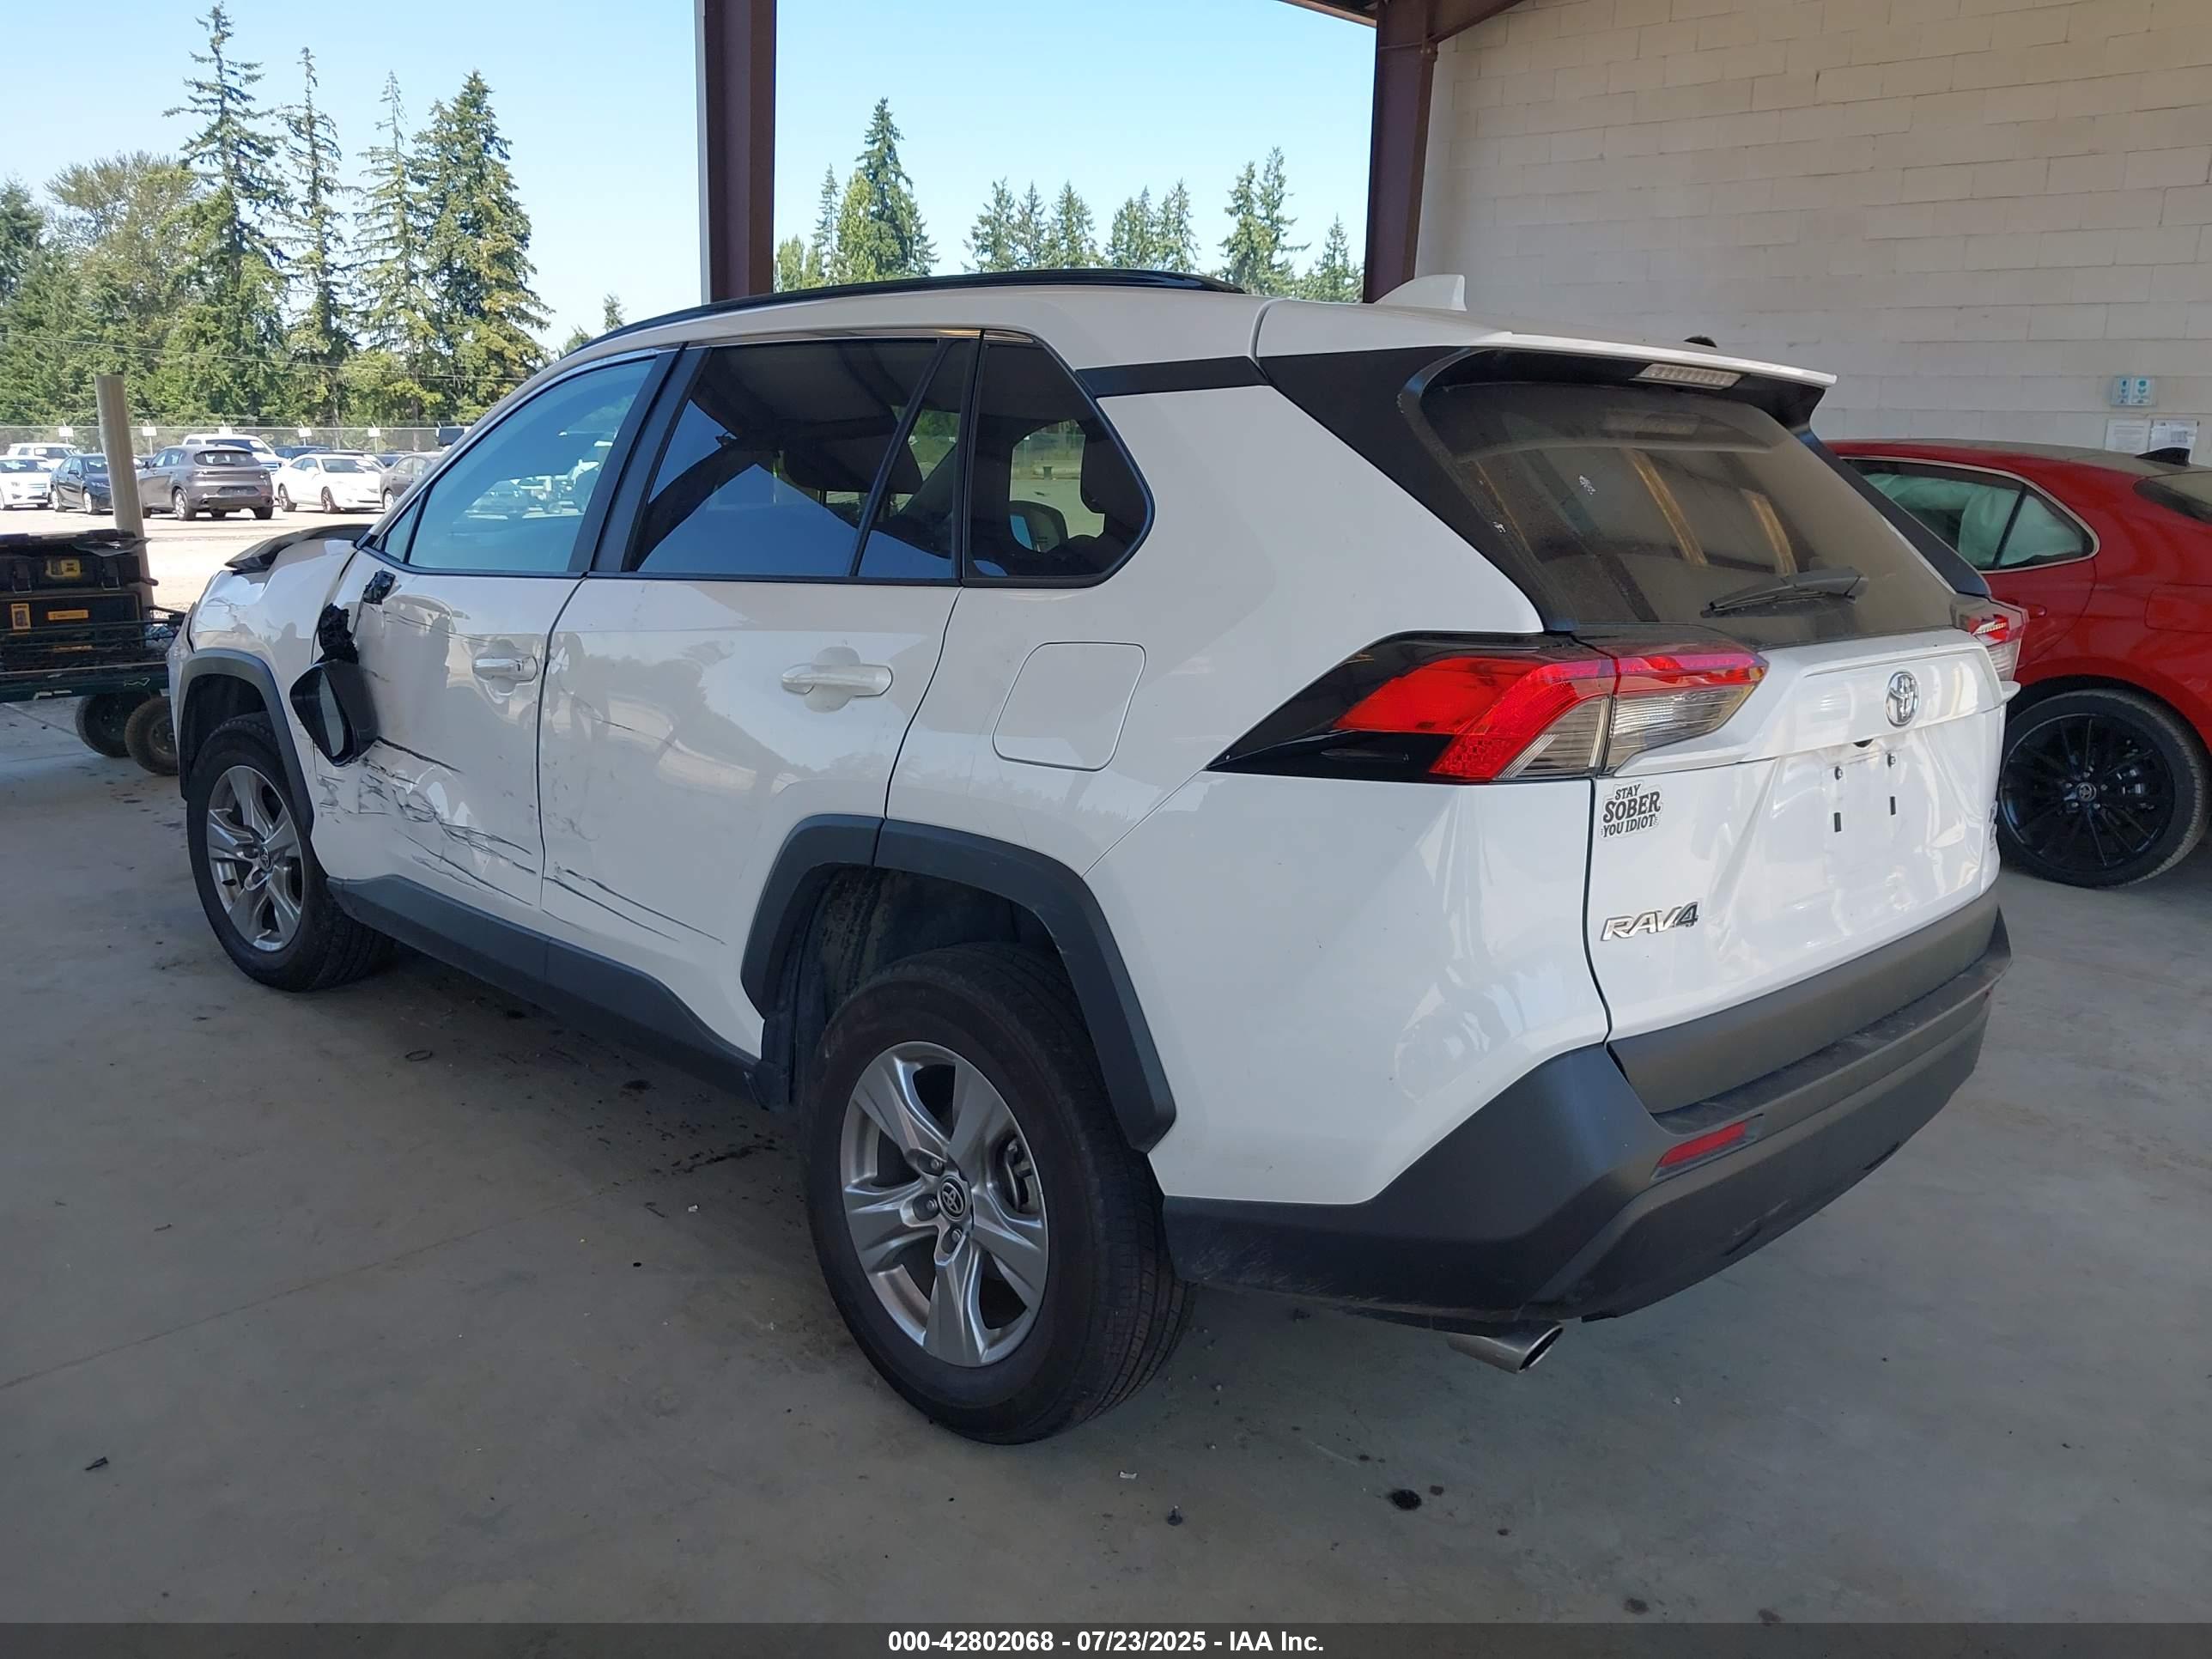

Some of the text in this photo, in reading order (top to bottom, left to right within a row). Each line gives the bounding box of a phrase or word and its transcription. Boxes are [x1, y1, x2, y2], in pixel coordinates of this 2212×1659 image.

[1614, 784, 1641, 800] STAY
[1603, 791, 1662, 823] SOBER
[1603, 814, 1656, 837] YOU IDIOT
[1601, 902, 1699, 941] RAV4
